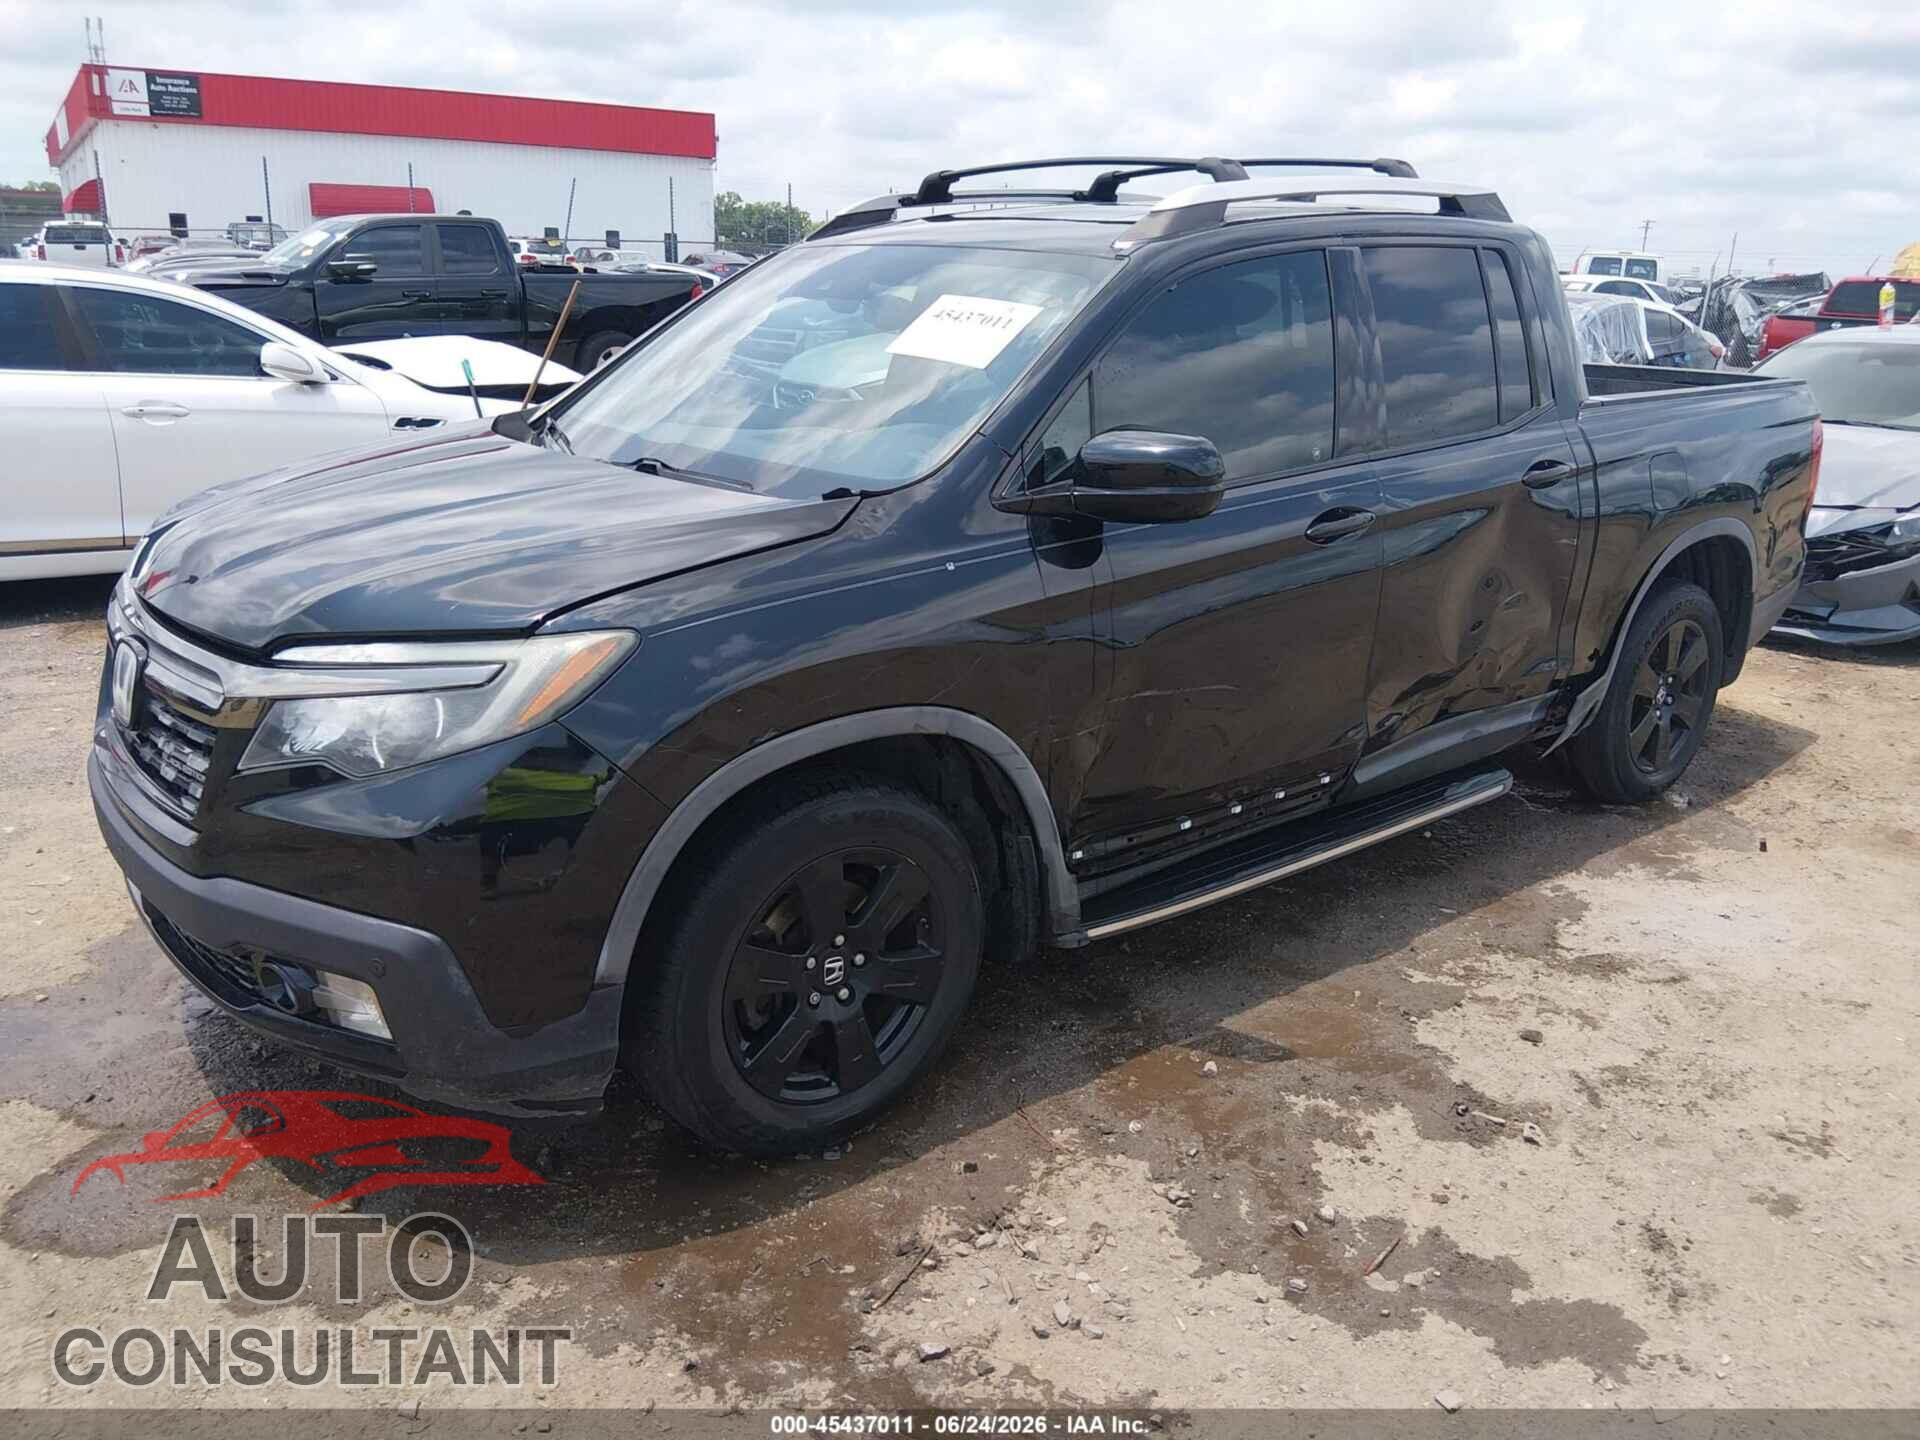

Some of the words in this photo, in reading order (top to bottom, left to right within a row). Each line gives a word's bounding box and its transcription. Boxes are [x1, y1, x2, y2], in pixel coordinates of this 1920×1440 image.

[156, 76, 189, 85] Insurance
[168, 85, 197, 94] Auctions
[932, 309, 1013, 329] 45437011
